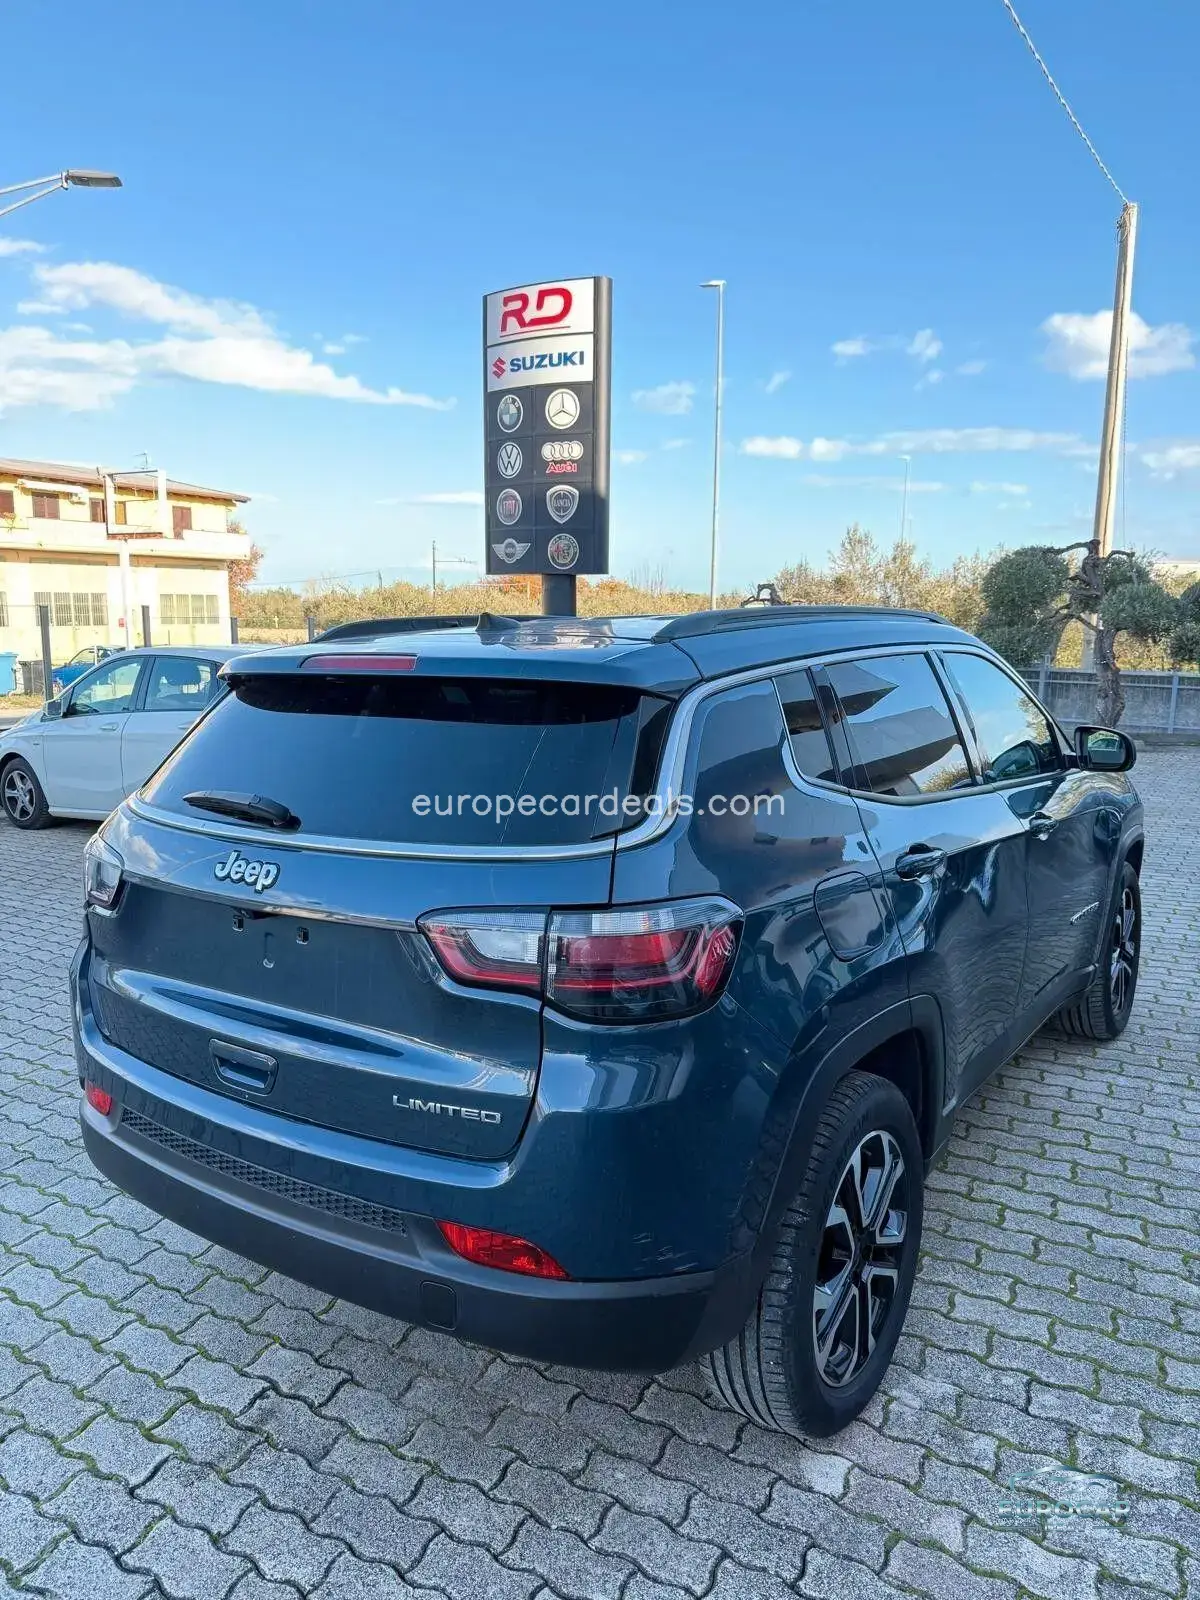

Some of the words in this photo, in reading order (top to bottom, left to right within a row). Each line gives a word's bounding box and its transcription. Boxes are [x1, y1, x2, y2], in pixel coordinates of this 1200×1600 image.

[500, 288, 573, 333] RD
[509, 351, 585, 372] SUZUKI
[546, 461, 578, 473] Audi
[214, 850, 280, 894] Jeep
[392, 1095, 502, 1124] LIMITED
